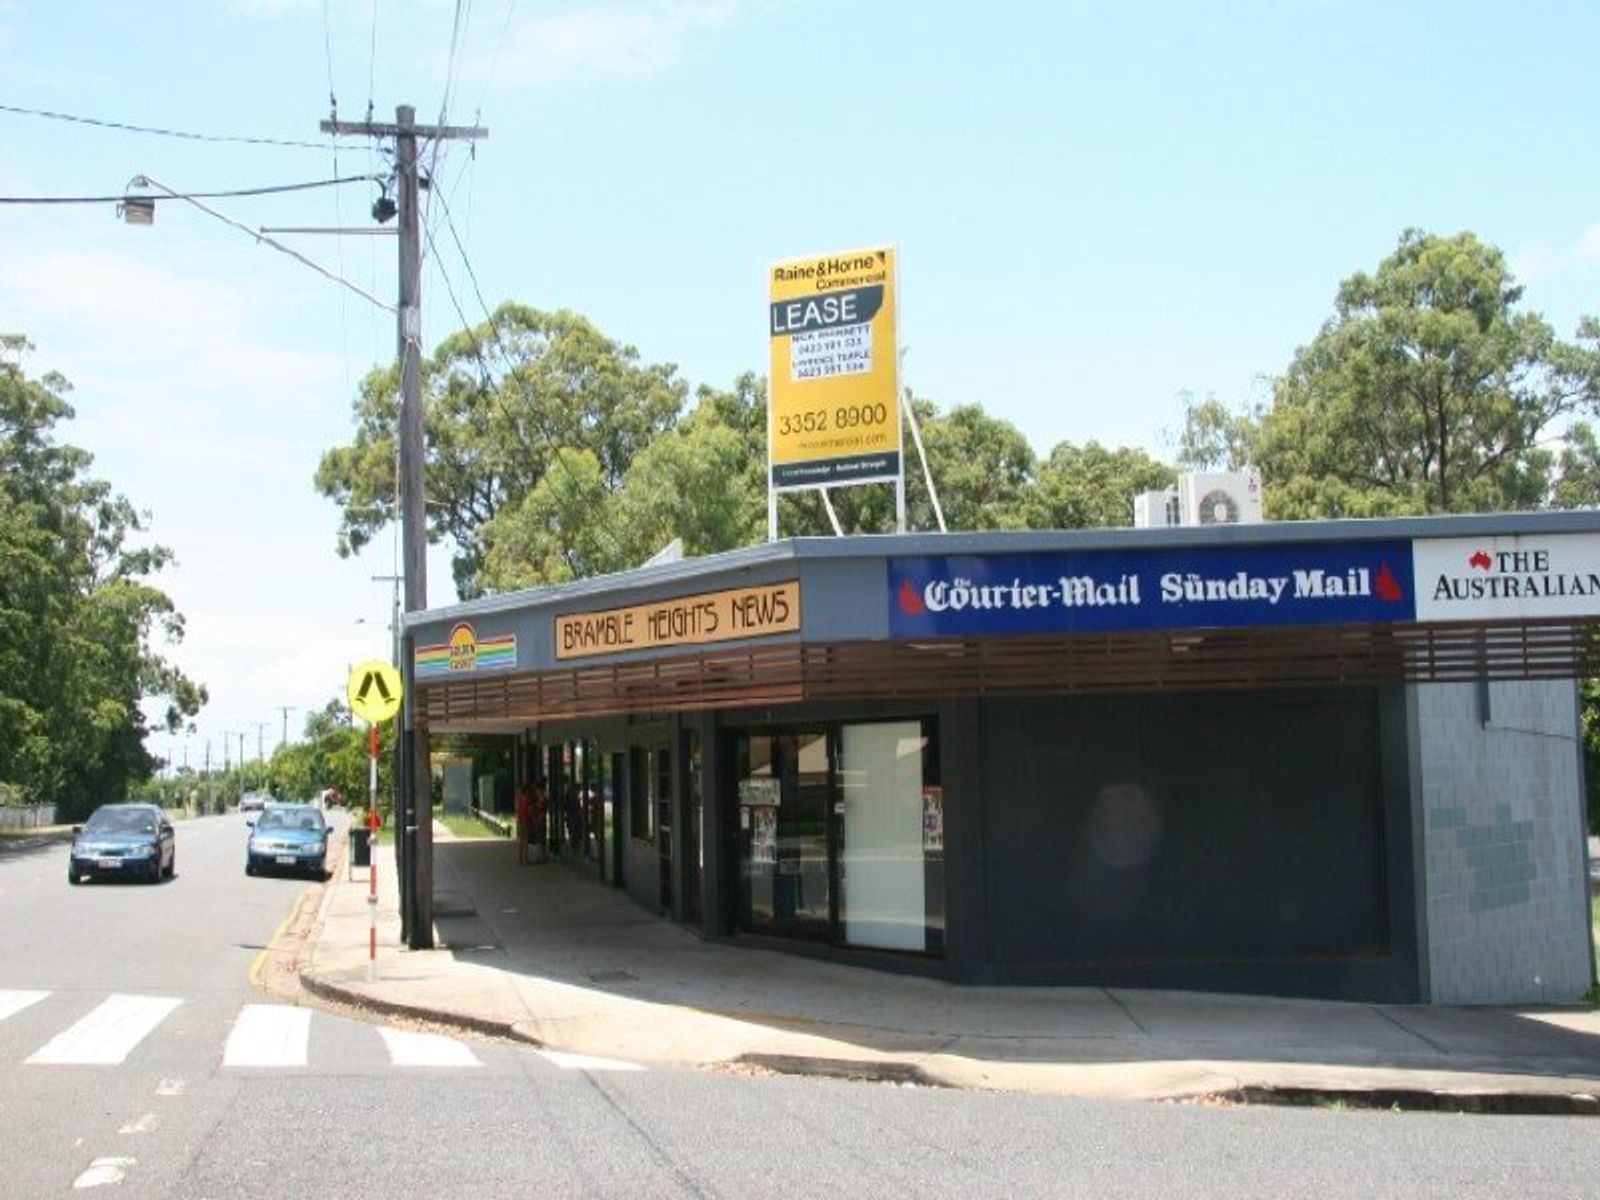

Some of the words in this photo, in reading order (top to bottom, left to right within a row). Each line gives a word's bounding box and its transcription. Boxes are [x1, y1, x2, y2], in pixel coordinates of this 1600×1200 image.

[816, 271, 886, 291] Commercial
[773, 294, 857, 332] LEASE
[779, 409, 828, 435] 3352
[835, 402, 887, 429] 8900
[1496, 550, 1549, 573] THE
[1160, 571, 1288, 604] Sunday
[1292, 568, 1370, 599] Mail
[563, 613, 634, 650] BRAMBLE
[648, 602, 719, 641] HEIGHTS
[731, 590, 789, 629] NEWS
